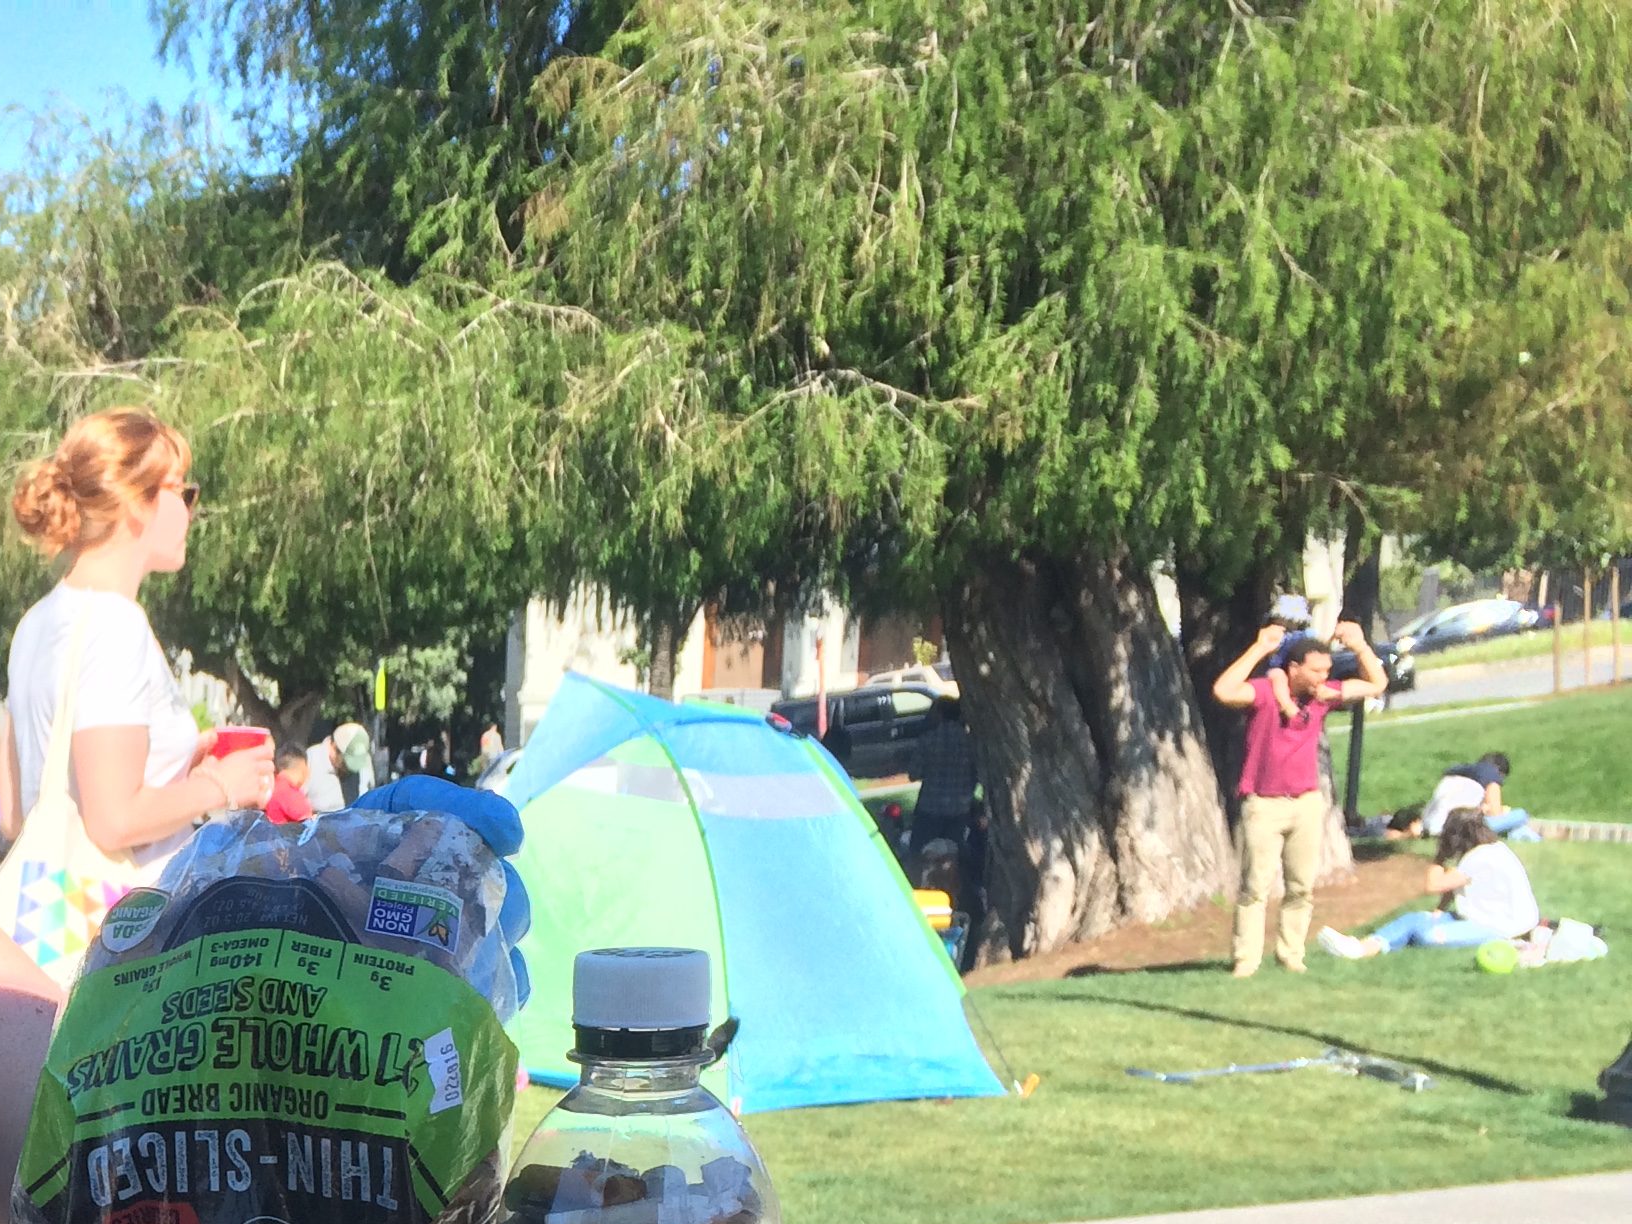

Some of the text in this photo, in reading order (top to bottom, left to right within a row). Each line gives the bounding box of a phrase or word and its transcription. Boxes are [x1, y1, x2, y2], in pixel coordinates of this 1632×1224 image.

[376, 900, 414, 914] Project
[378, 889, 457, 915] VERIFIED
[373, 918, 410, 933] NON
[374, 908, 413, 923] GMO
[112, 924, 151, 939] SDA
[211, 937, 270, 952] OMEGA-3
[290, 940, 333, 959] FIBER
[210, 952, 263, 968] 140mg
[297, 957, 320, 975] 3g
[353, 952, 415, 976] PROTEIN
[113, 965, 157, 987] GRAINS
[370, 971, 394, 991] 3g
[160, 976, 328, 1024] AND SEEDS
[211, 1016, 369, 1082] WHOLE
[66, 1024, 208, 1101] GRAINS
[440, 1043, 460, 1102] 022816
[141, 1082, 328, 1120] ORGANIC BREAD
